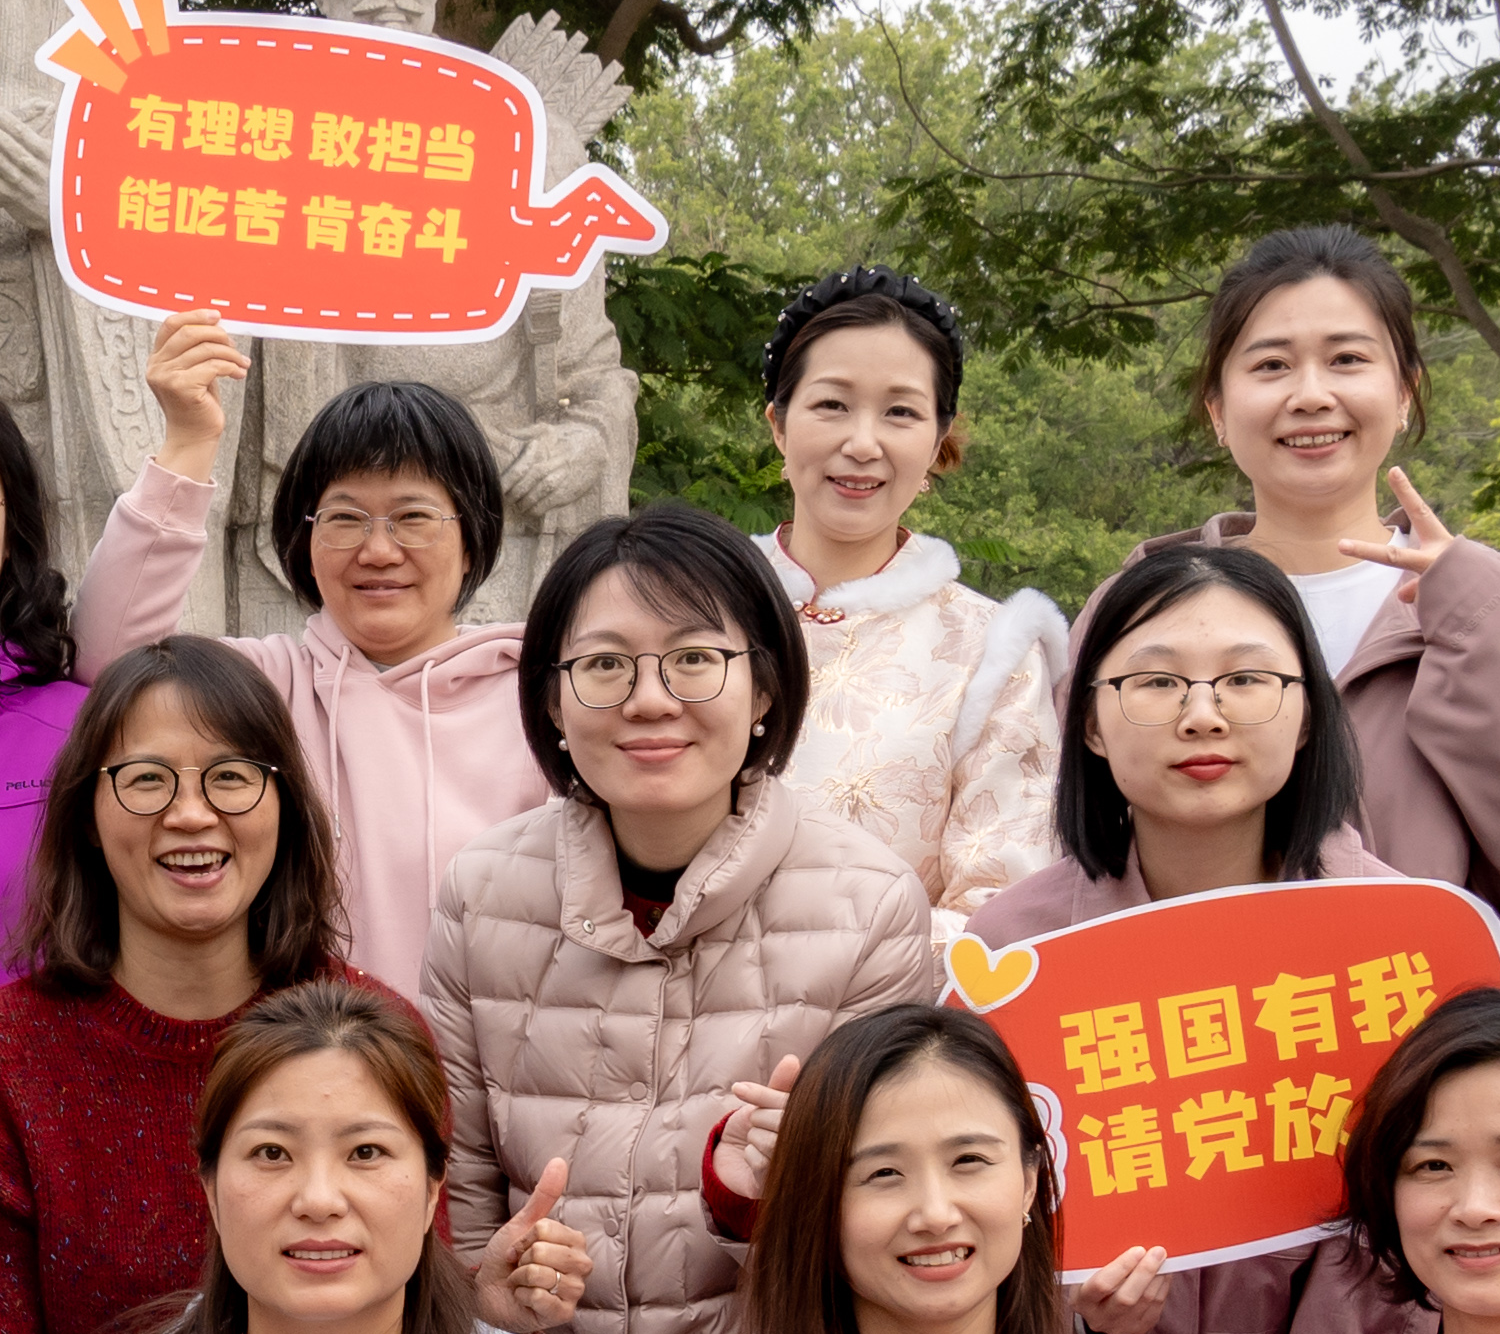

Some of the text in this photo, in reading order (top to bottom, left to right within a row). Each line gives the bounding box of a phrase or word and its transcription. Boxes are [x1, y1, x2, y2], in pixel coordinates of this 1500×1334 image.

[125, 93, 476, 182] 有理想 敢担当
[117, 175, 469, 264] 能吃苦 肯奋斗
[1059, 951, 1438, 1095] 强国有我
[1077, 1072, 1355, 1197] 请党放
